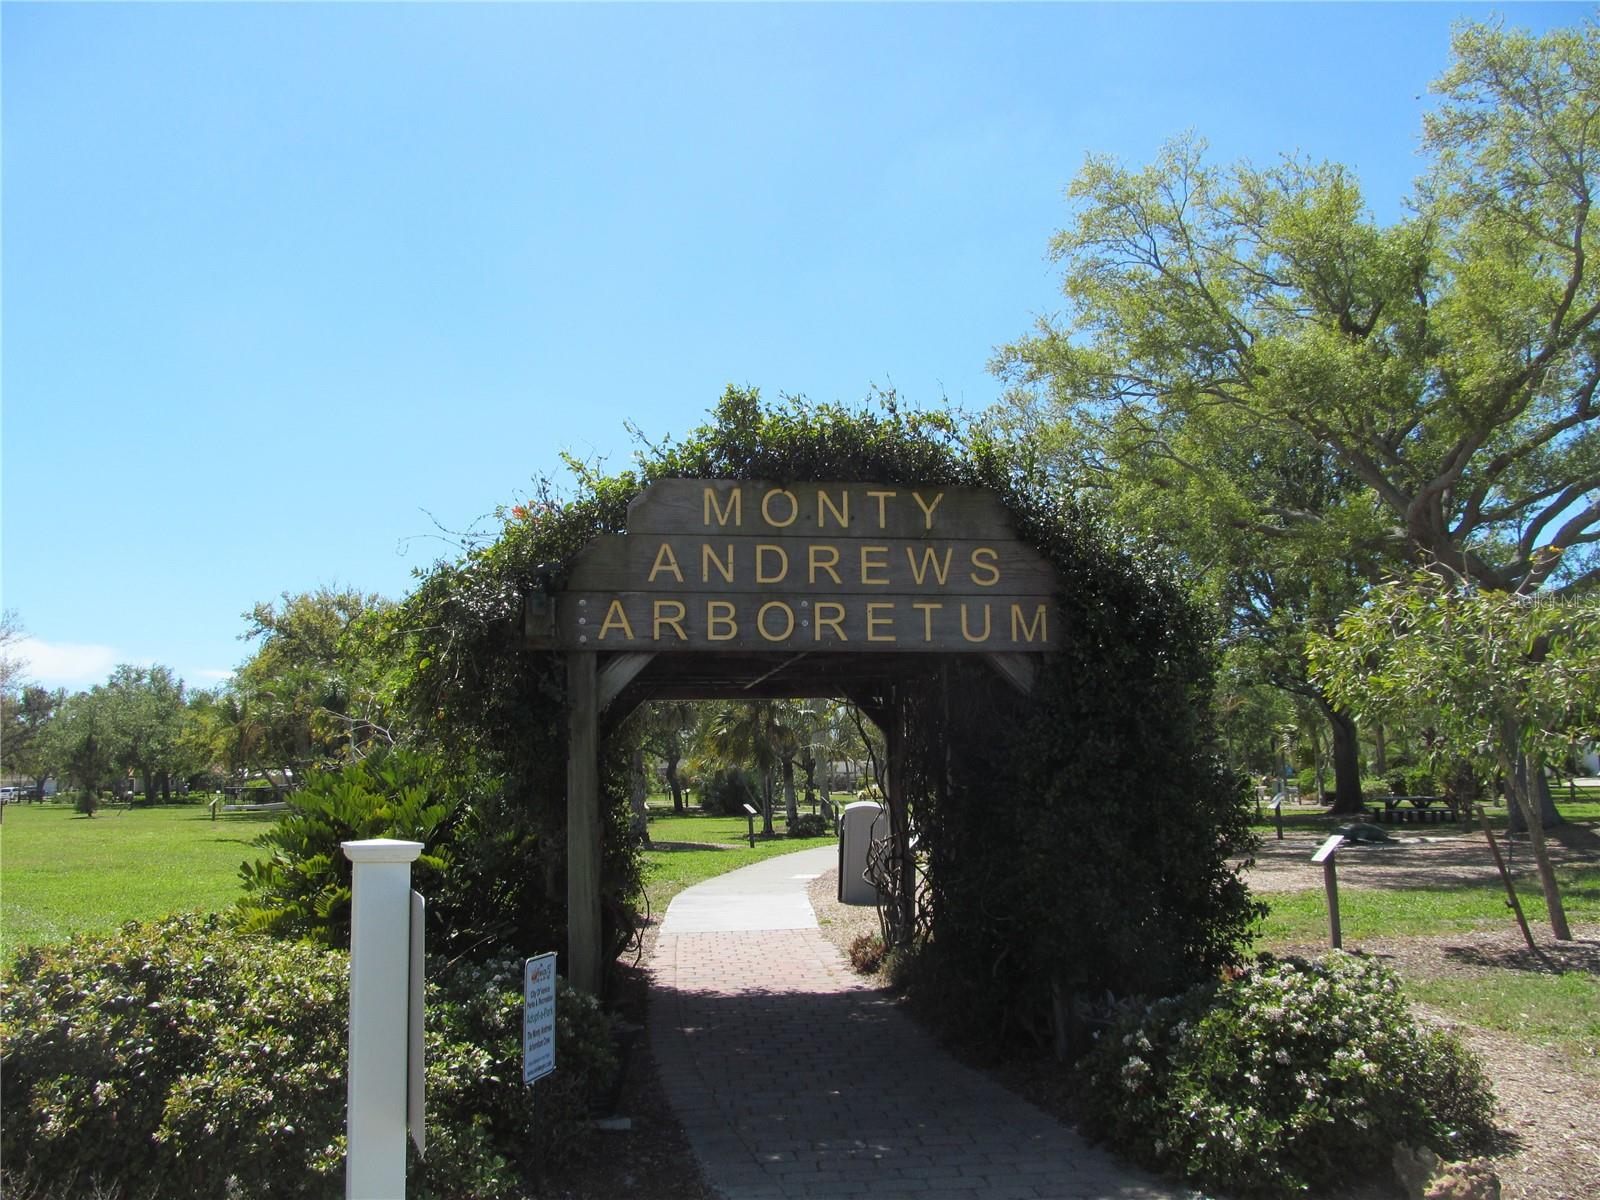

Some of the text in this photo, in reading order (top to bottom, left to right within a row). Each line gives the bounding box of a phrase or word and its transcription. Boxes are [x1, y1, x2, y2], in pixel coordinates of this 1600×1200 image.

[703, 488, 944, 531] MONTY
[648, 542, 1001, 586] ANDREWS
[597, 599, 1048, 643] ARBORETUM
